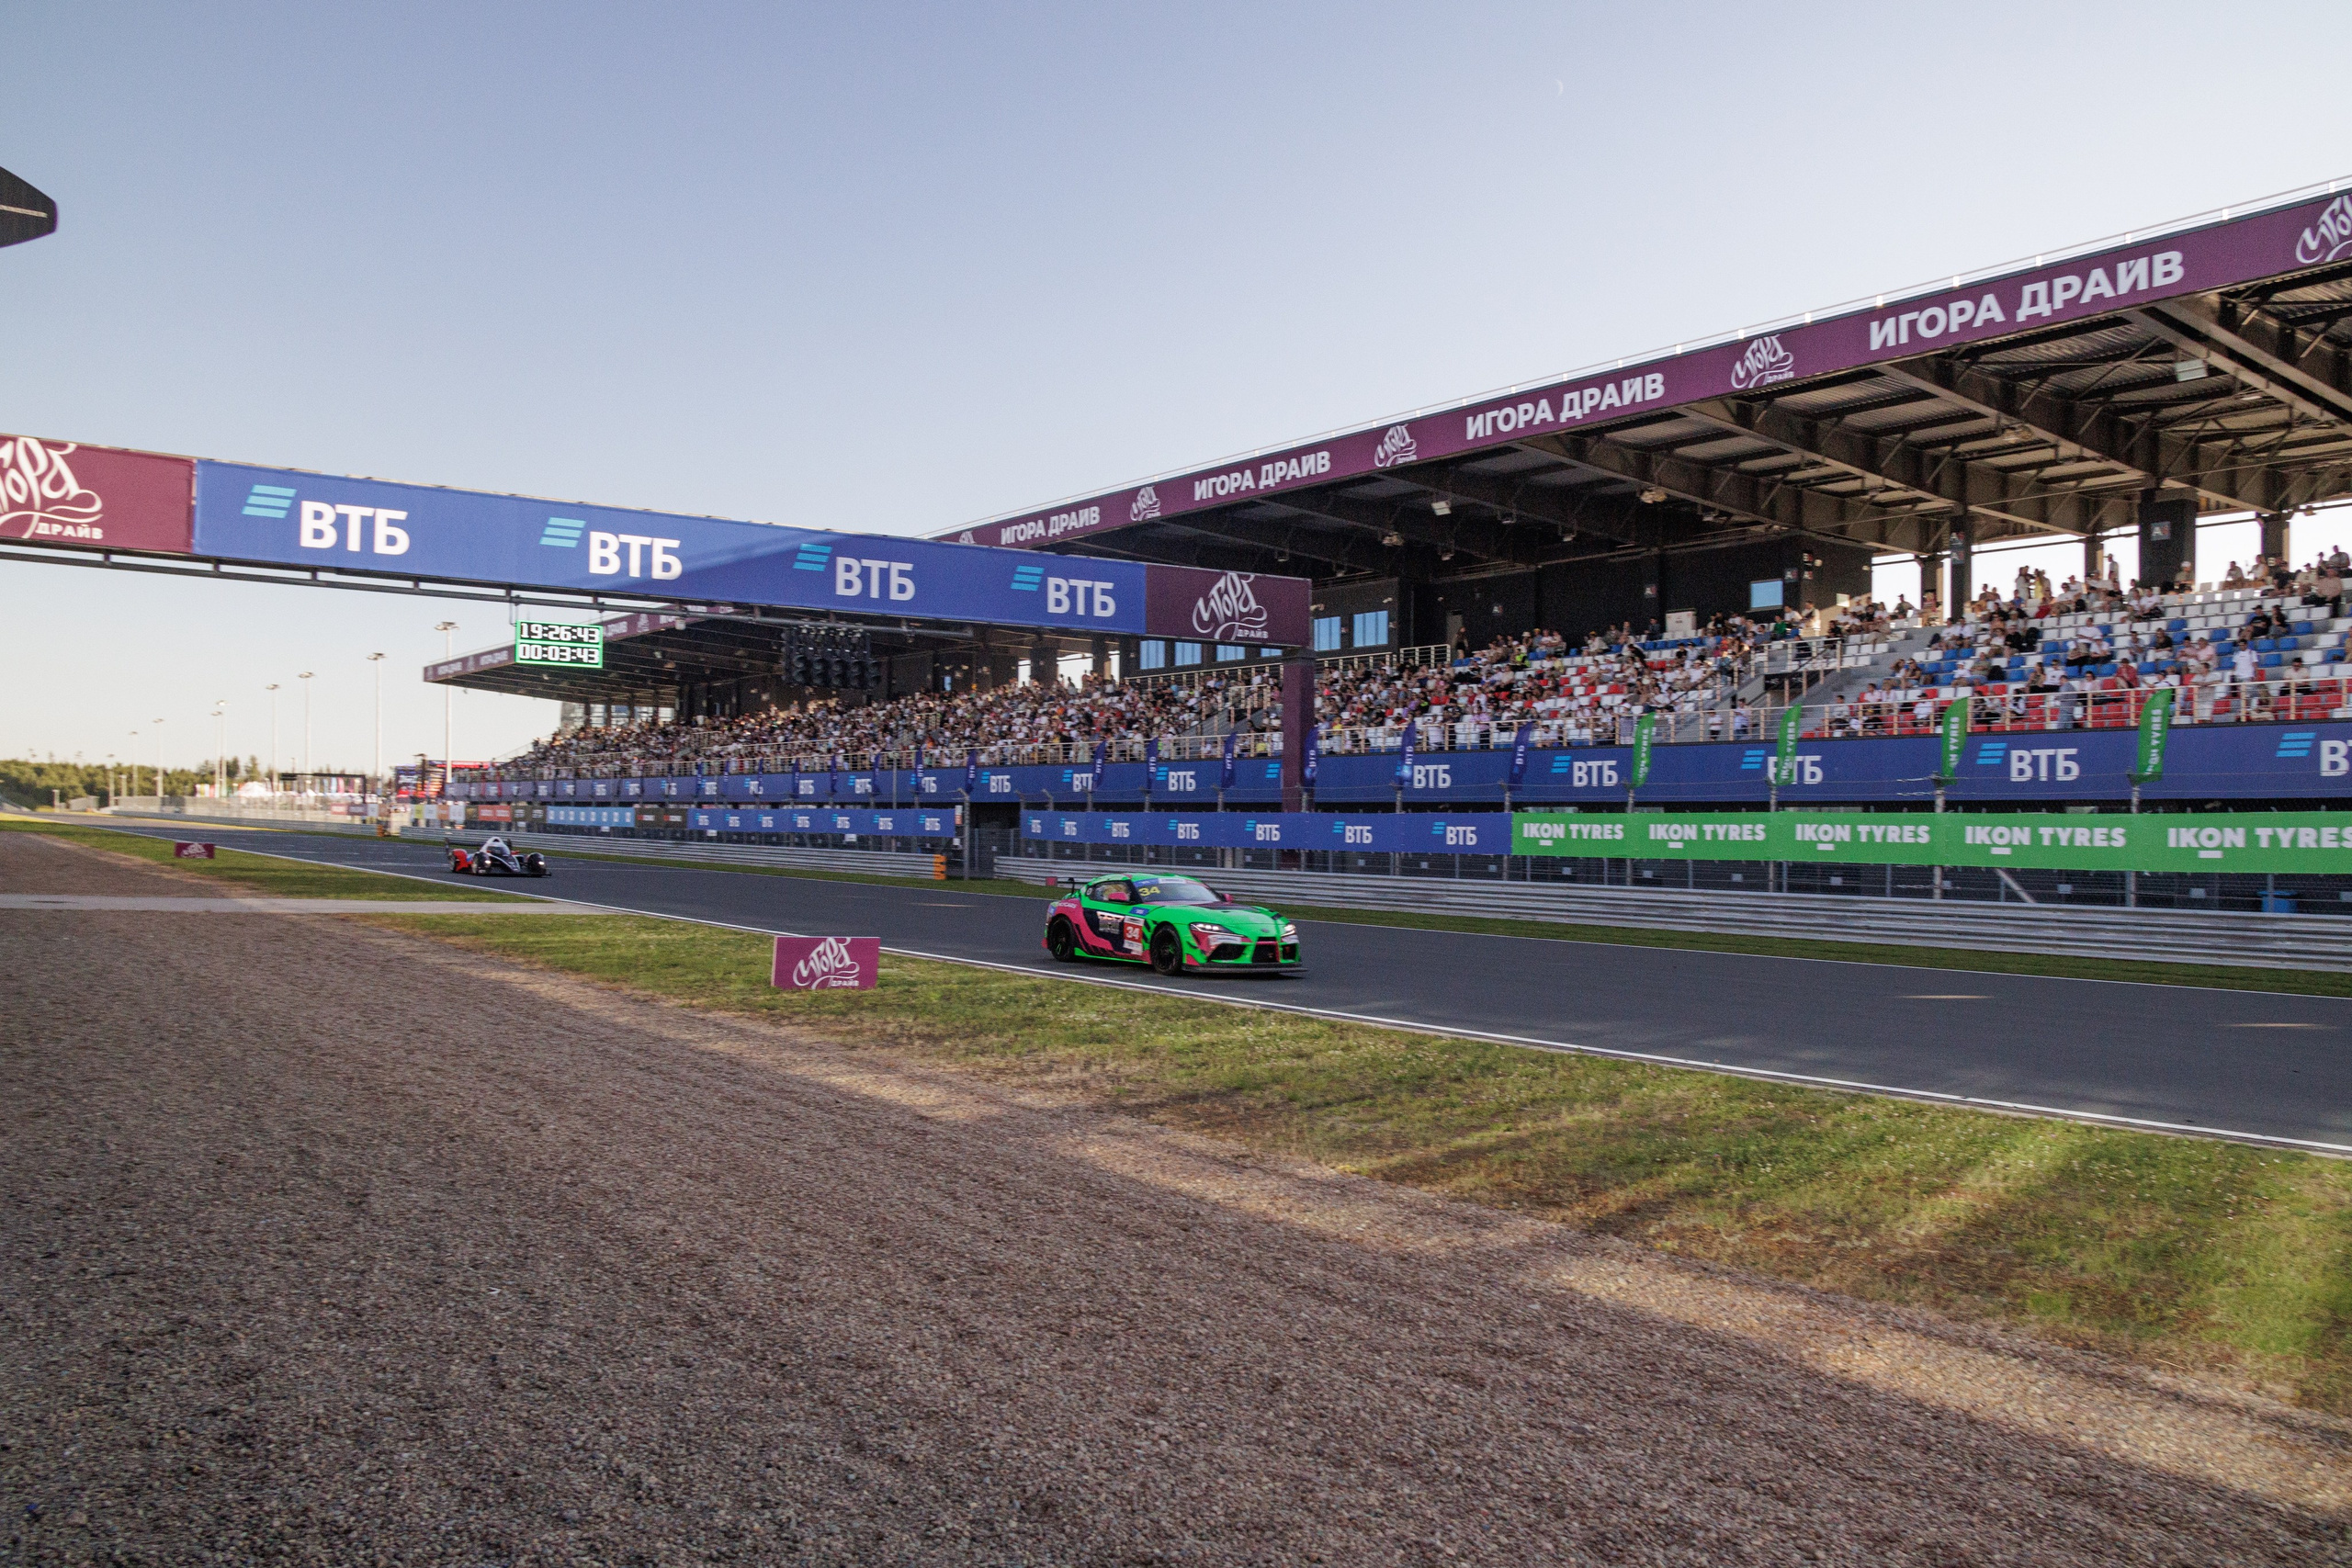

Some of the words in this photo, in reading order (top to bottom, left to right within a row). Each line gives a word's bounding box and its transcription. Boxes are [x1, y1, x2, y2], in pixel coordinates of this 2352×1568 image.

[1870, 293, 2006, 351] ИГОРА
[1465, 399, 1555, 440] ИГОРА
[1194, 469, 1255, 501] ИГОРА
[35, 522, 104, 540] ДРАЙВ
[300, 500, 411, 556] ВТБ
[1001, 519, 1046, 545] ИГОРА
[588, 530, 683, 581] ВТБ
[835, 556, 916, 602] ВТБ
[1046, 576, 1116, 618] ВТБ
[520, 623, 600, 643] 19:26:43
[518, 643, 600, 663] 00:03:43
[1572, 760, 1619, 787] ВТБ
[2010, 748, 2080, 782] ВТБ
[989, 774, 1012, 793] ВТБ
[1168, 771, 1196, 792] ВТБ
[1413, 764, 1452, 789] ВТБ
[1111, 822, 1130, 838] ВТБ
[1177, 823, 1200, 840] ВТБ
[1255, 824, 1281, 841] ВТБ
[1345, 826, 1373, 843] ВТБ
[1445, 827, 1477, 845] ВТБ
[1522, 823, 1565, 839] IKON
[1568, 824, 1623, 840] TYRES
[1648, 823, 1698, 840] IKON
[1702, 824, 1766, 841] TYRES
[1795, 823, 1851, 842] IKON
[1857, 825, 1930, 843] TYRES
[1964, 826, 2031, 845] IKON
[2038, 827, 2127, 847] TYRES
[2166, 827, 2246, 848] IKON
[1138, 886, 1161, 897] 34
[1125, 926, 1141, 940] 34
